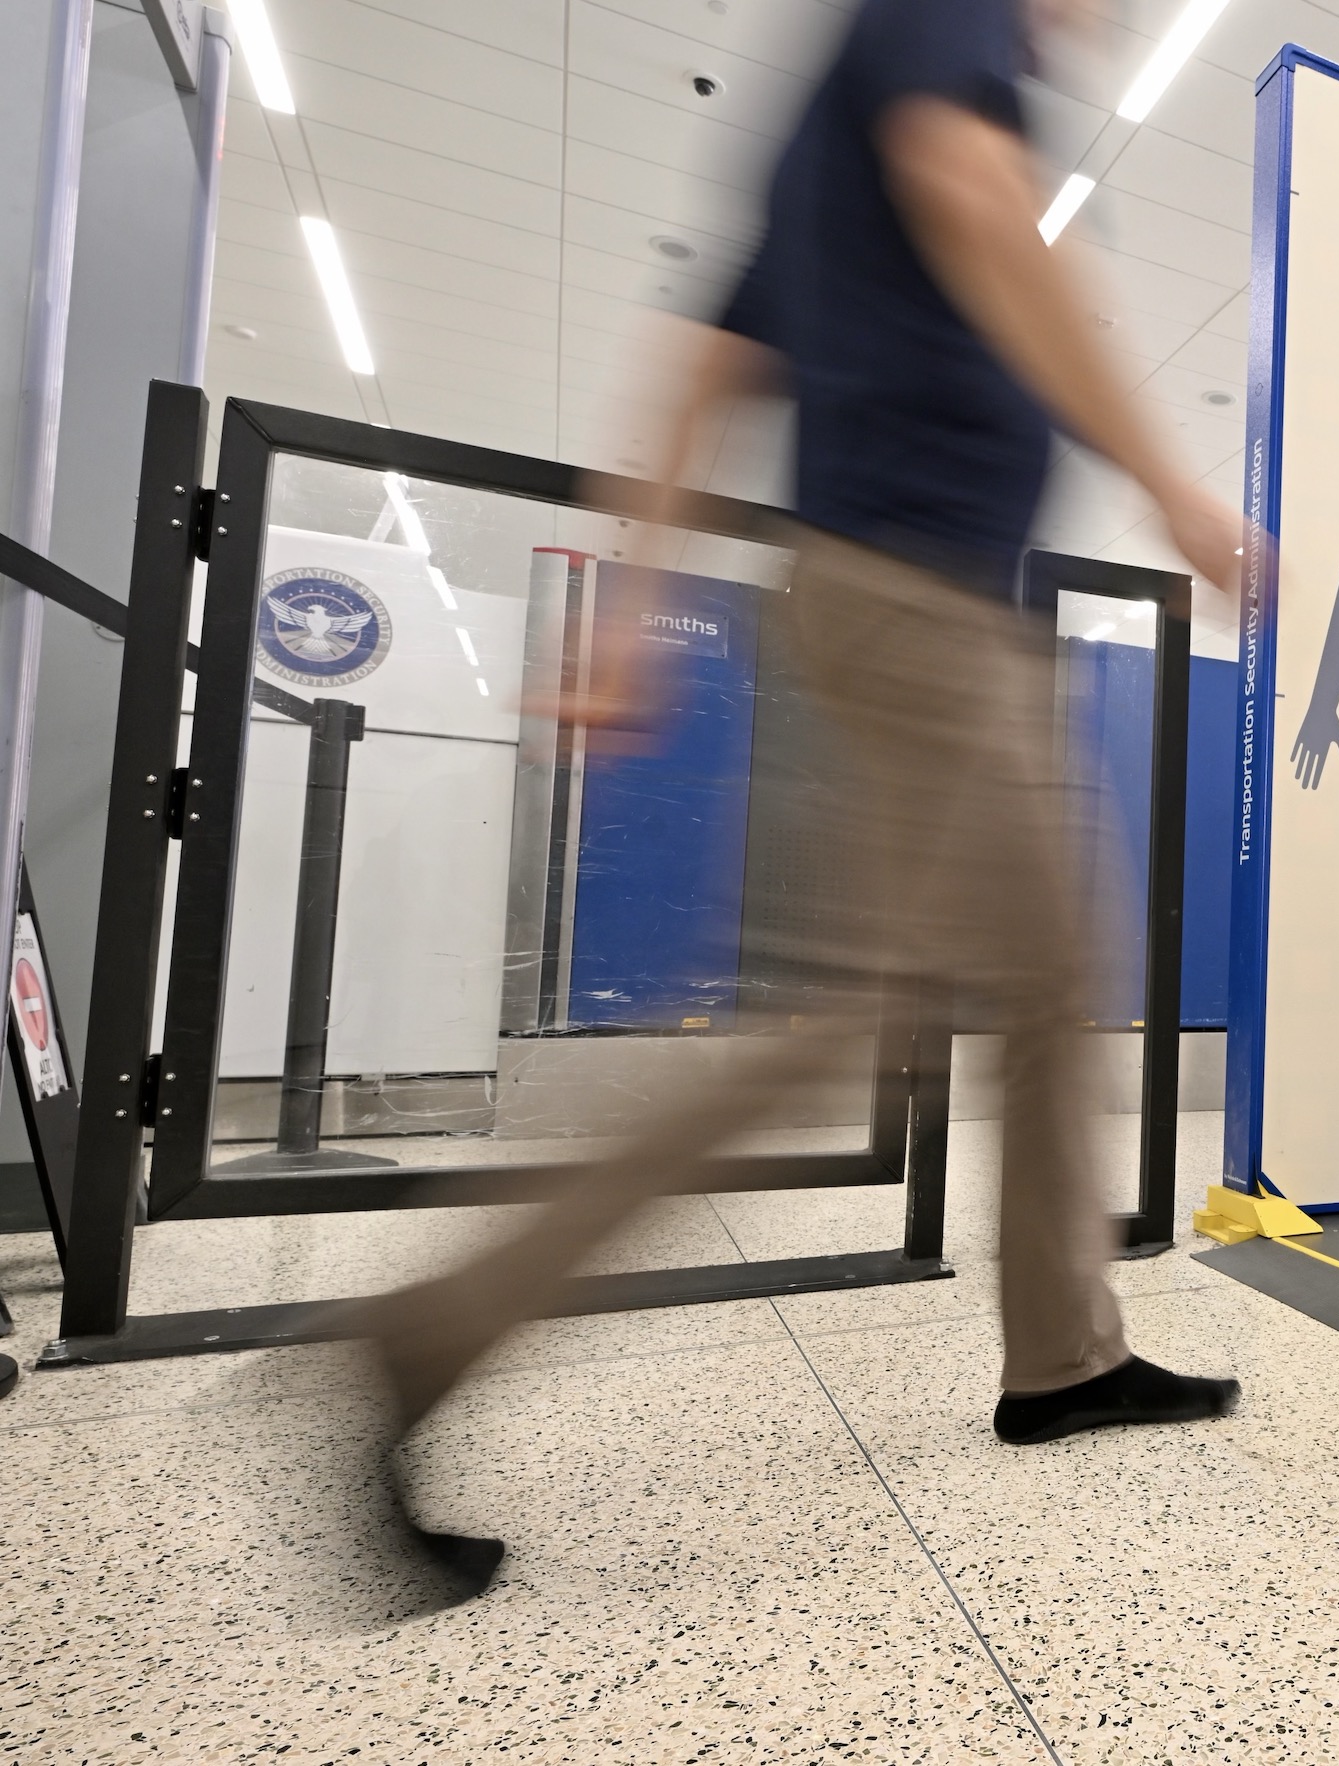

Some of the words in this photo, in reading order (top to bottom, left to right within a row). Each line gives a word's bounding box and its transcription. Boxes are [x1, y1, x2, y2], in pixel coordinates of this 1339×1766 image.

[1247, 437, 1263, 599] Administration
[356, 585, 392, 647] SECURITY
[640, 613, 718, 636] smiths
[1244, 606, 1259, 695] Security
[256, 647, 378, 688] DMINISTRATION
[1239, 699, 1255, 866] Transportation
